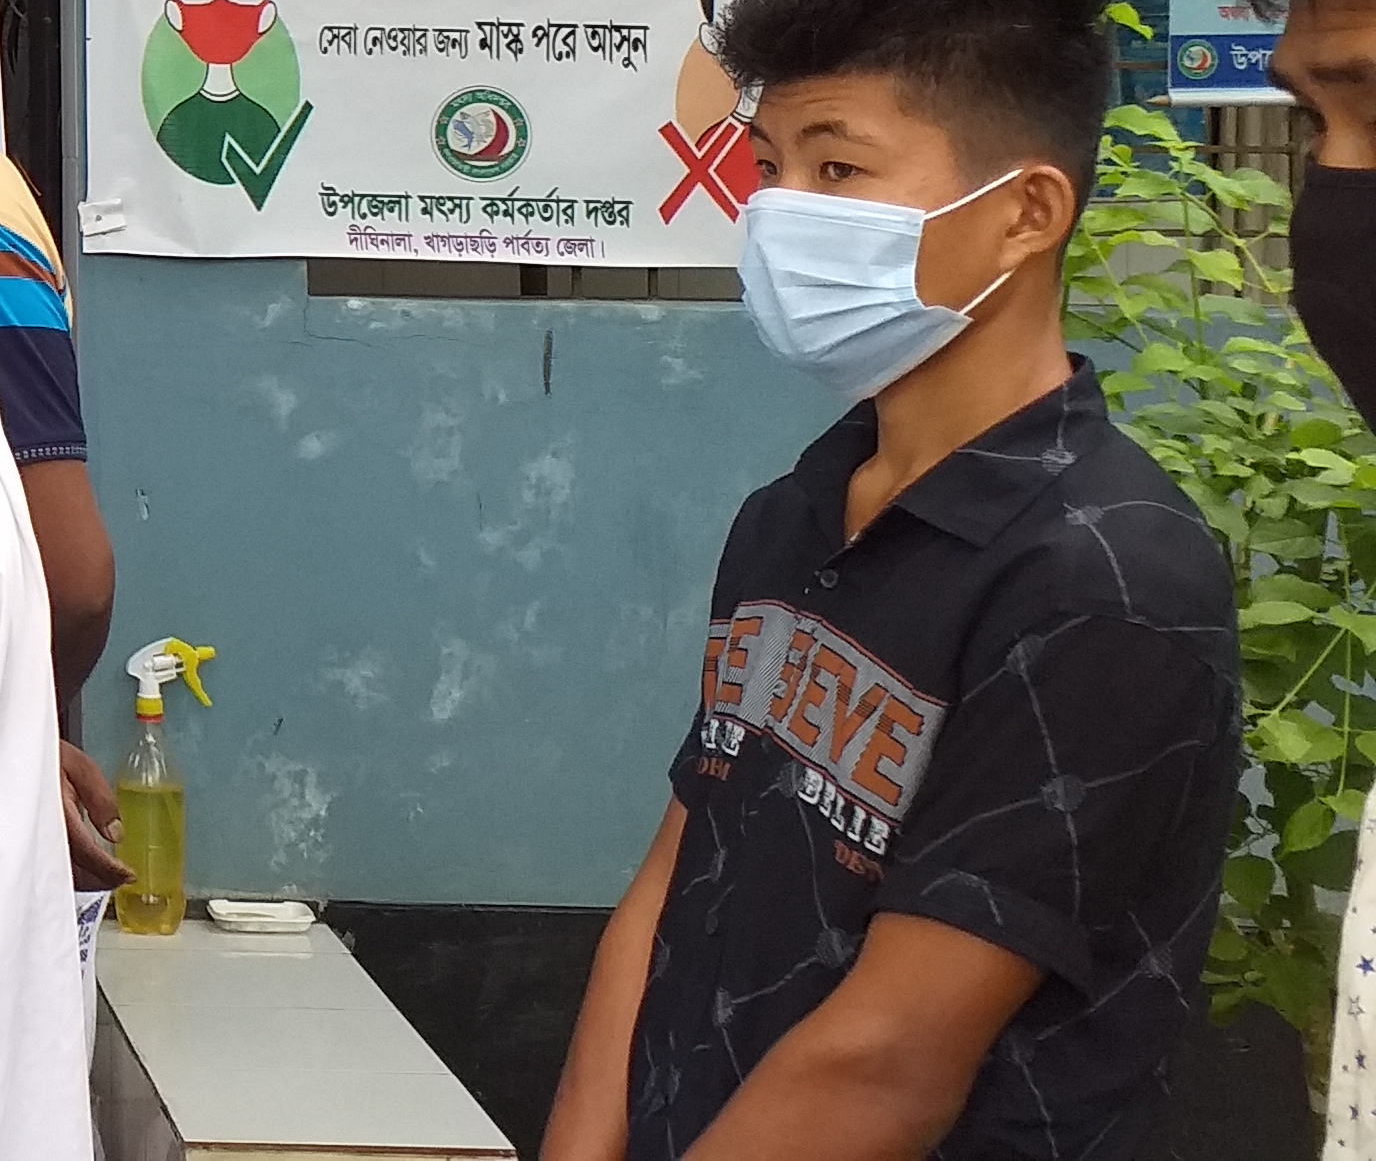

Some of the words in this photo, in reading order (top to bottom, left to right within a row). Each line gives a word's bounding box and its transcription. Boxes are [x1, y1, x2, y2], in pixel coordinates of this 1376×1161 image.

[319, 23, 358, 56] সেবা
[364, 24, 428, 58] নেওয়ার
[432, 28, 470, 60] জন্য
[475, 17, 525, 63] মাস্ক
[532, 18, 578, 63] পরে
[583, 19, 650, 72] আসুন
[318, 182, 413, 223] উপজেলা
[417, 194, 474, 225] মৎস্য
[479, 186, 578, 228] কর্মকর্তার
[584, 196, 634, 229] দপ্তর
[424, 228, 498, 259] খাগড়াছড়ি
[503, 229, 551, 257] পার্বত্য
